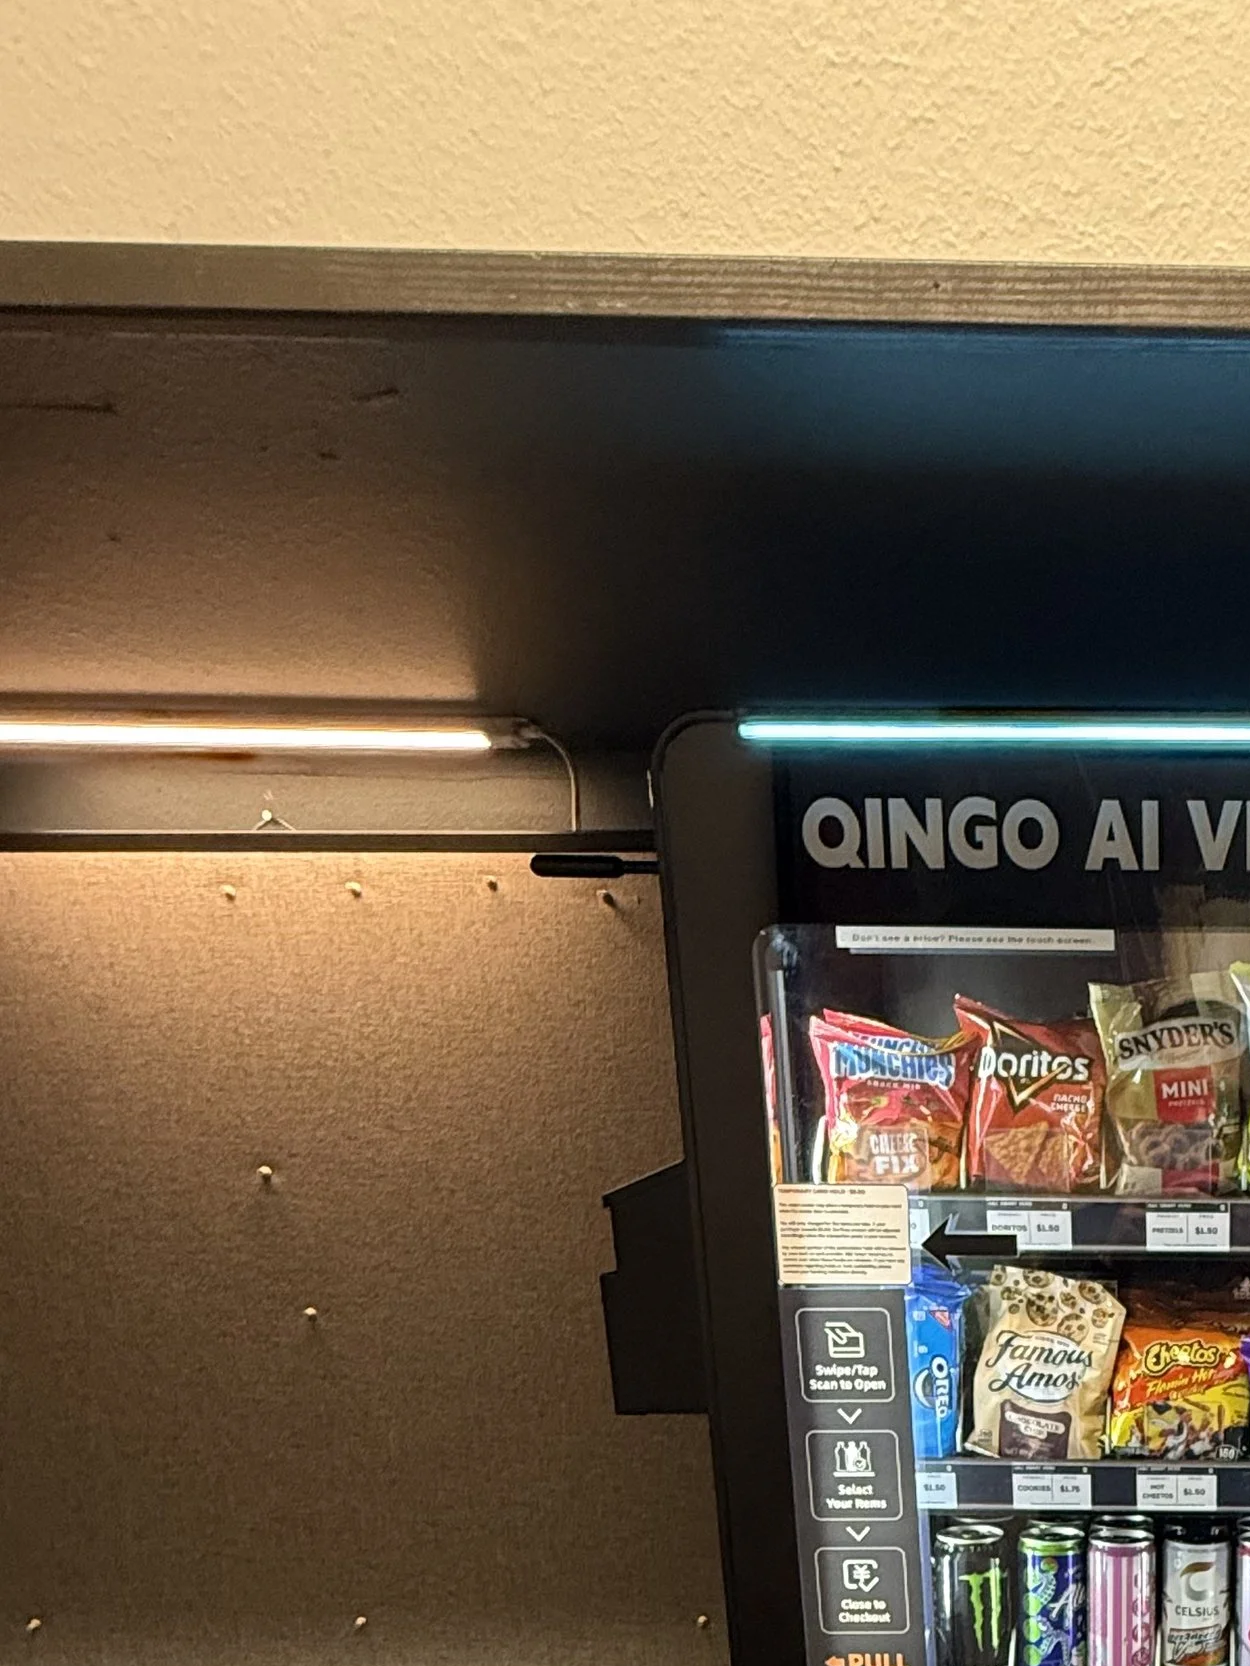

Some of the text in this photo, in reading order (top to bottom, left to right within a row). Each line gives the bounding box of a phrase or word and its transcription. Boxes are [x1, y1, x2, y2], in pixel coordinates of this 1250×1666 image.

[802, 797, 1059, 870] QINGO
[1085, 799, 1159, 871] AI
[882, 934, 900, 943] see
[903, 935, 910, 943] a
[913, 934, 945, 944] price?
[949, 934, 983, 943] Please
[986, 935, 1004, 943] see
[1007, 935, 1023, 944] the
[1026, 935, 1055, 945] touch
[1118, 1020, 1236, 1061] SNYDER'S
[834, 1042, 956, 1089] MUNCHIES
[978, 1046, 1091, 1083] Doritos
[1160, 1078, 1210, 1100] MINI
[874, 1153, 920, 1176] FIX
[991, 1224, 1028, 1233] DORITOS
[1036, 1224, 1060, 1234] $1.50
[1195, 1226, 1219, 1235] $1.50
[985, 1329, 1094, 1368] Famous
[1144, 1341, 1220, 1374] Cheetos
[814, 1364, 879, 1378] Swipe/Tap
[988, 1362, 1083, 1392] Amos
[809, 1378, 887, 1392] Scan to Open
[930, 1355, 950, 1418] OREO
[837, 1484, 874, 1496] Select
[1017, 1484, 1051, 1492] COOKIES
[1060, 1484, 1081, 1493] $1.75
[825, 1498, 888, 1511] Your Items
[840, 1599, 887, 1611] Close to
[1174, 1604, 1221, 1618] CELSIUS
[838, 1611, 892, 1624] Checkout
